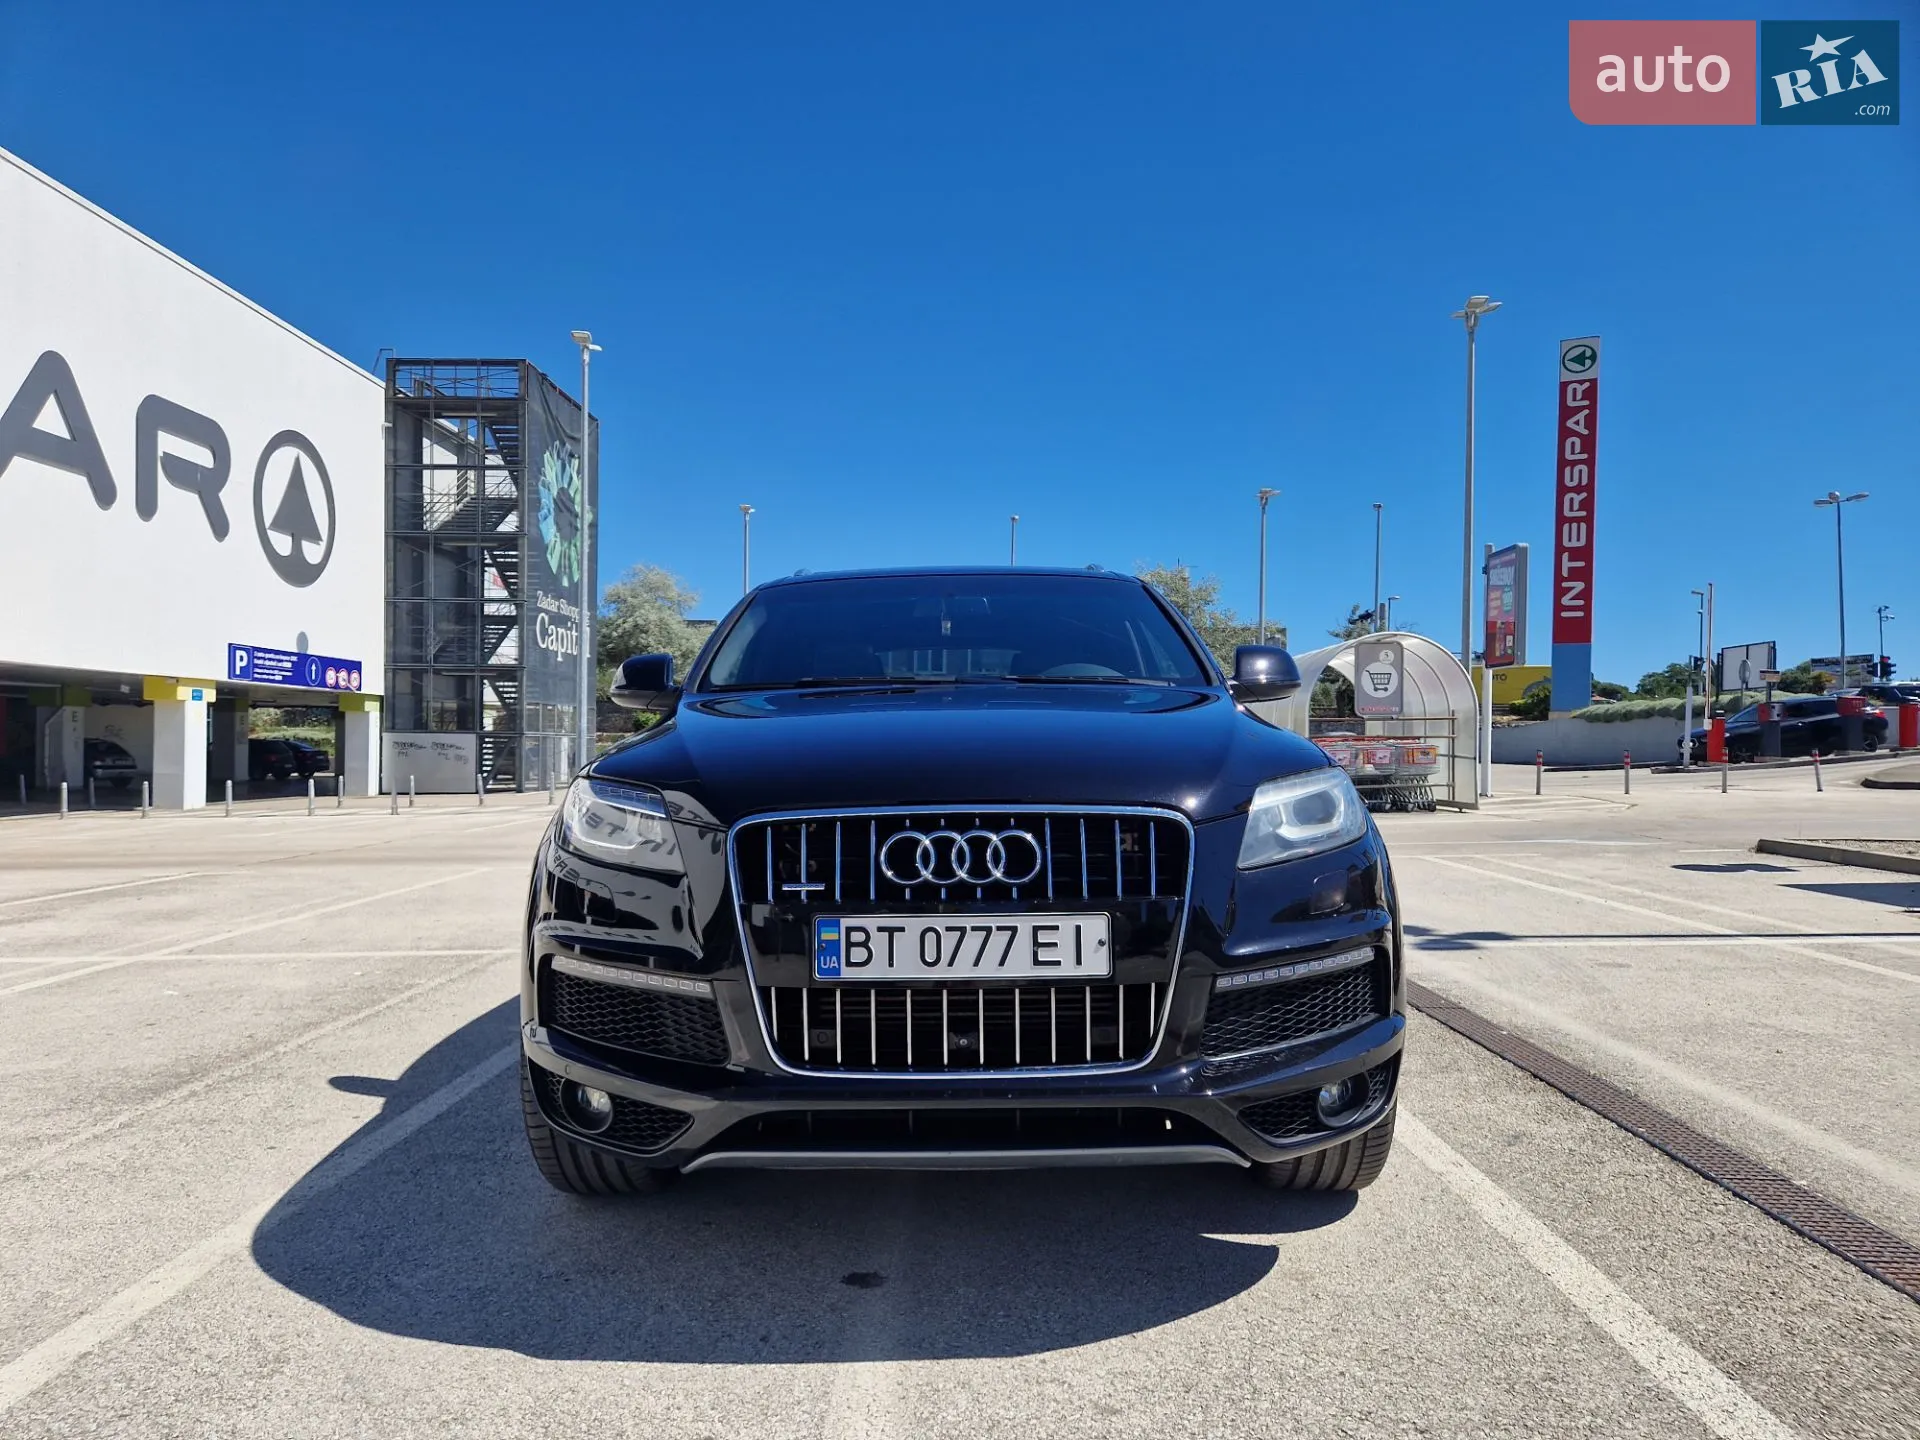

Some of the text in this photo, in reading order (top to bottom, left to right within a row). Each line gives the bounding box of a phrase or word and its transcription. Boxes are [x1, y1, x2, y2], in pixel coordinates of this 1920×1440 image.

[1560, 381, 1591, 618] INTERSPAR
[536, 590, 559, 613] Zadar
[536, 612, 591, 662] Capitl
[234, 649, 249, 676] P
[820, 956, 840, 969] UA
[844, 924, 1084, 968] BT 0777 EI
